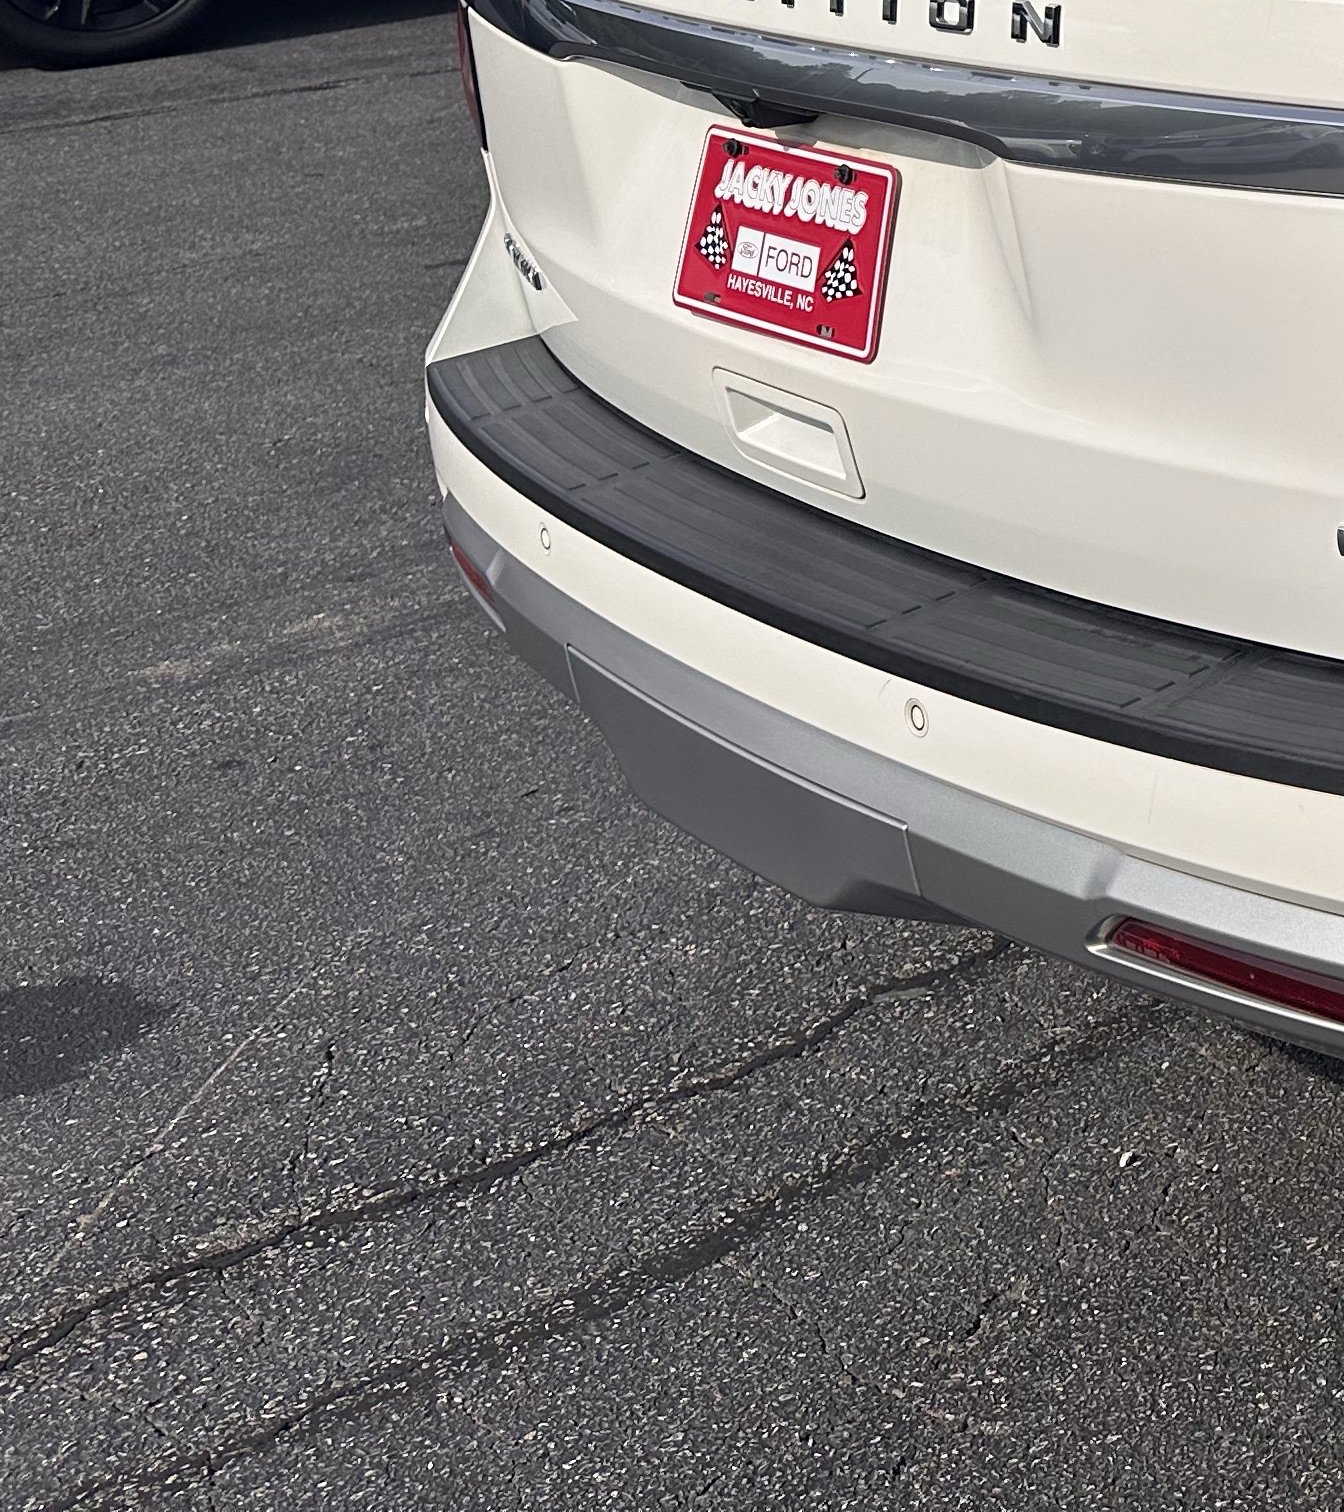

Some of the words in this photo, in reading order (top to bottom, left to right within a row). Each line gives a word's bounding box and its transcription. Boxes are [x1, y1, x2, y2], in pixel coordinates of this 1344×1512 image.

[714, 158, 793, 216] JACKY
[783, 176, 869, 235] JONES
[764, 246, 813, 278] FORD
[727, 274, 794, 310] HAYESVILLE,
[795, 294, 815, 312] NC
